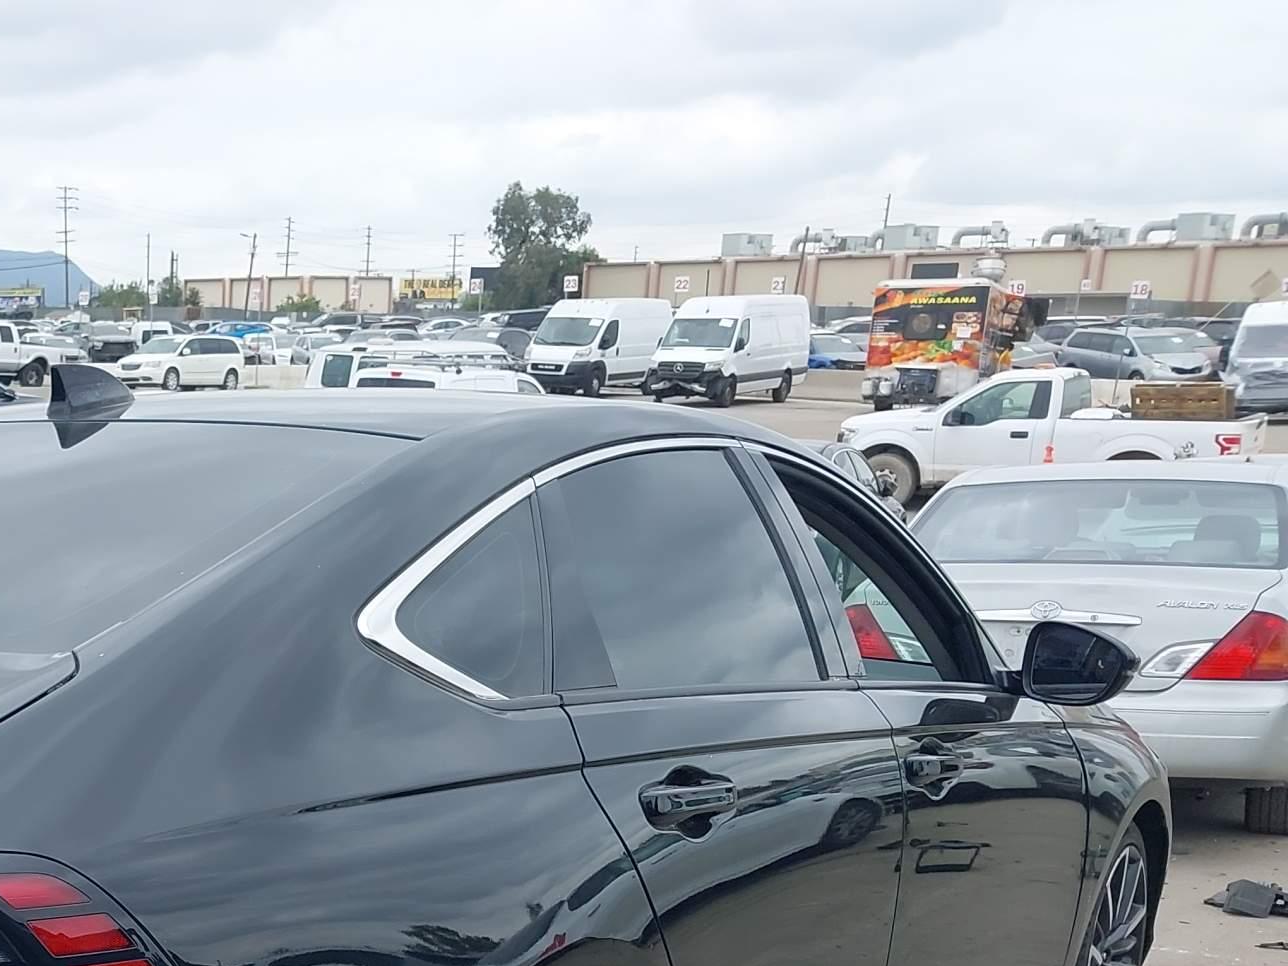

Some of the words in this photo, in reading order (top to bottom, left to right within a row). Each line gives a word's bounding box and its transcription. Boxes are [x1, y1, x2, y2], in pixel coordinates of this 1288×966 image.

[565, 278, 578, 289] 23
[675, 280, 689, 290] 22
[1010, 283, 1025, 294] 19
[1132, 284, 1148, 295] 18
[1156, 600, 1217, 610] AVALON
